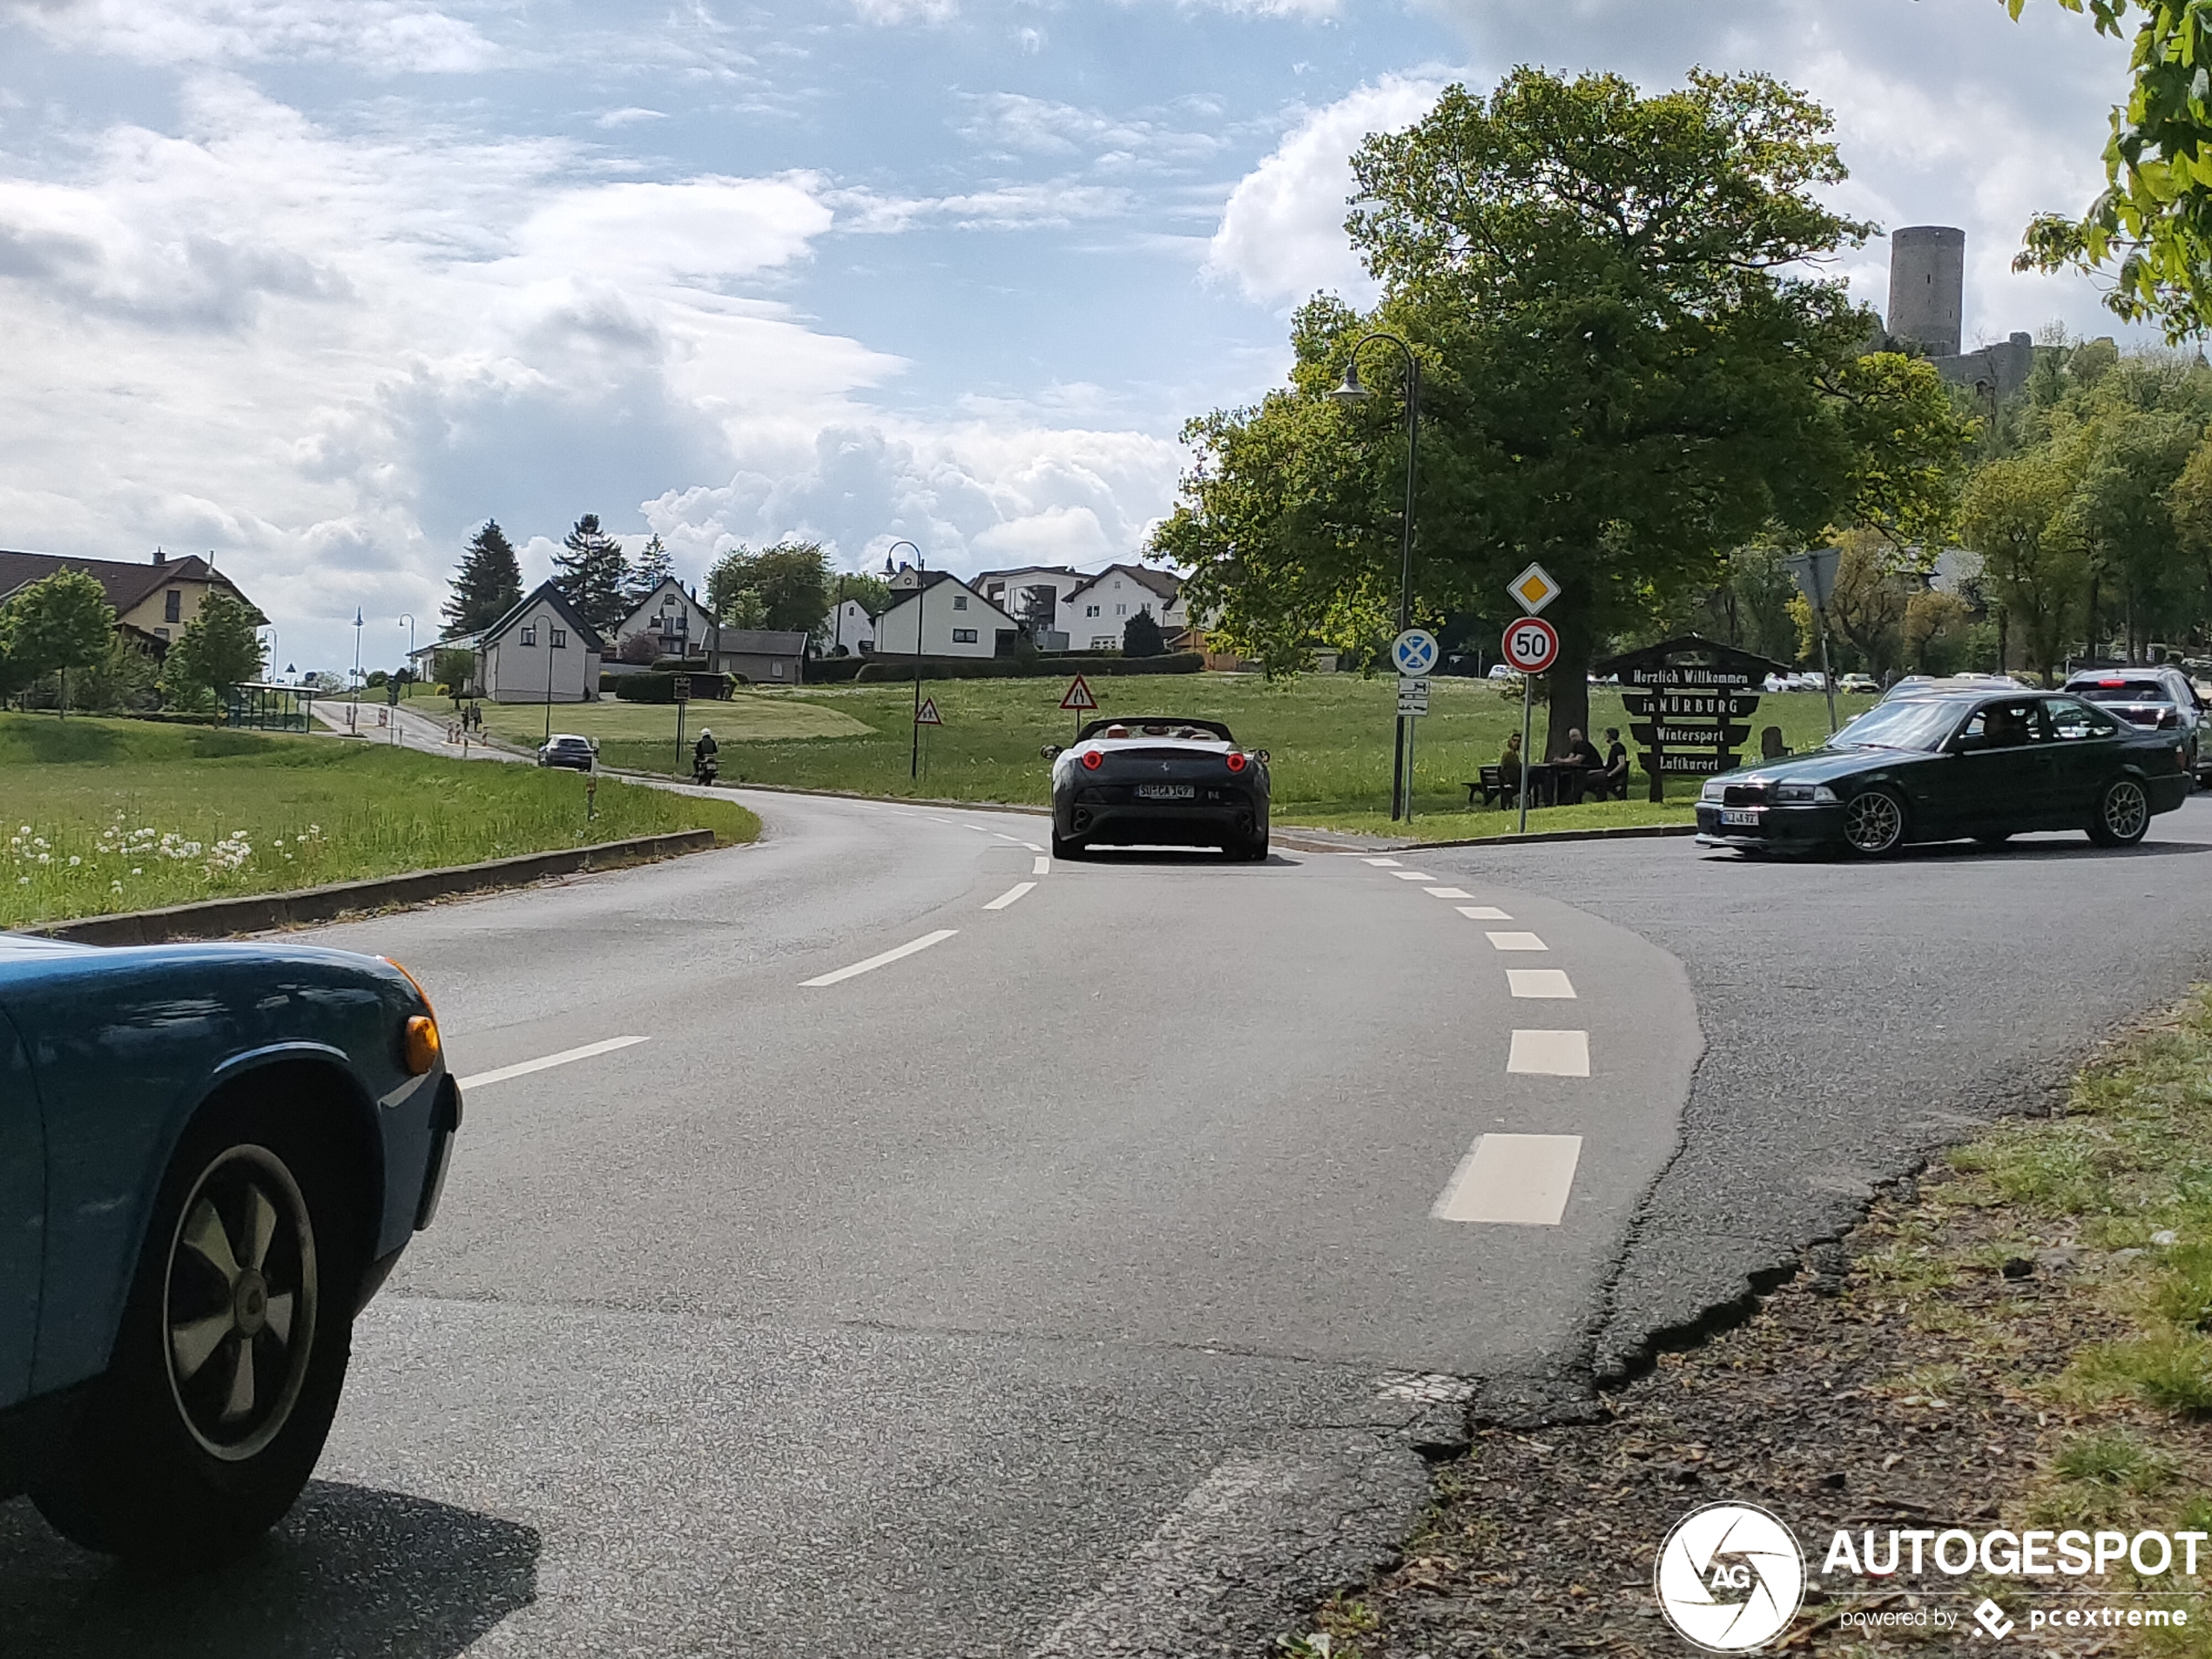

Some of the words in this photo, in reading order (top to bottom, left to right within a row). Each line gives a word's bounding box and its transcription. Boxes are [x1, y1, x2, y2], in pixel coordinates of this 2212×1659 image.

[1516, 633, 1547, 658] 50
[1634, 669, 1678, 684] Herzlich
[1684, 670, 1748, 684] Willkommen
[1643, 698, 1655, 712] in
[1659, 696, 1737, 712] NÜRBURG
[1656, 727, 1723, 743] Wintersport
[1660, 756, 1718, 771] Luftkurort
